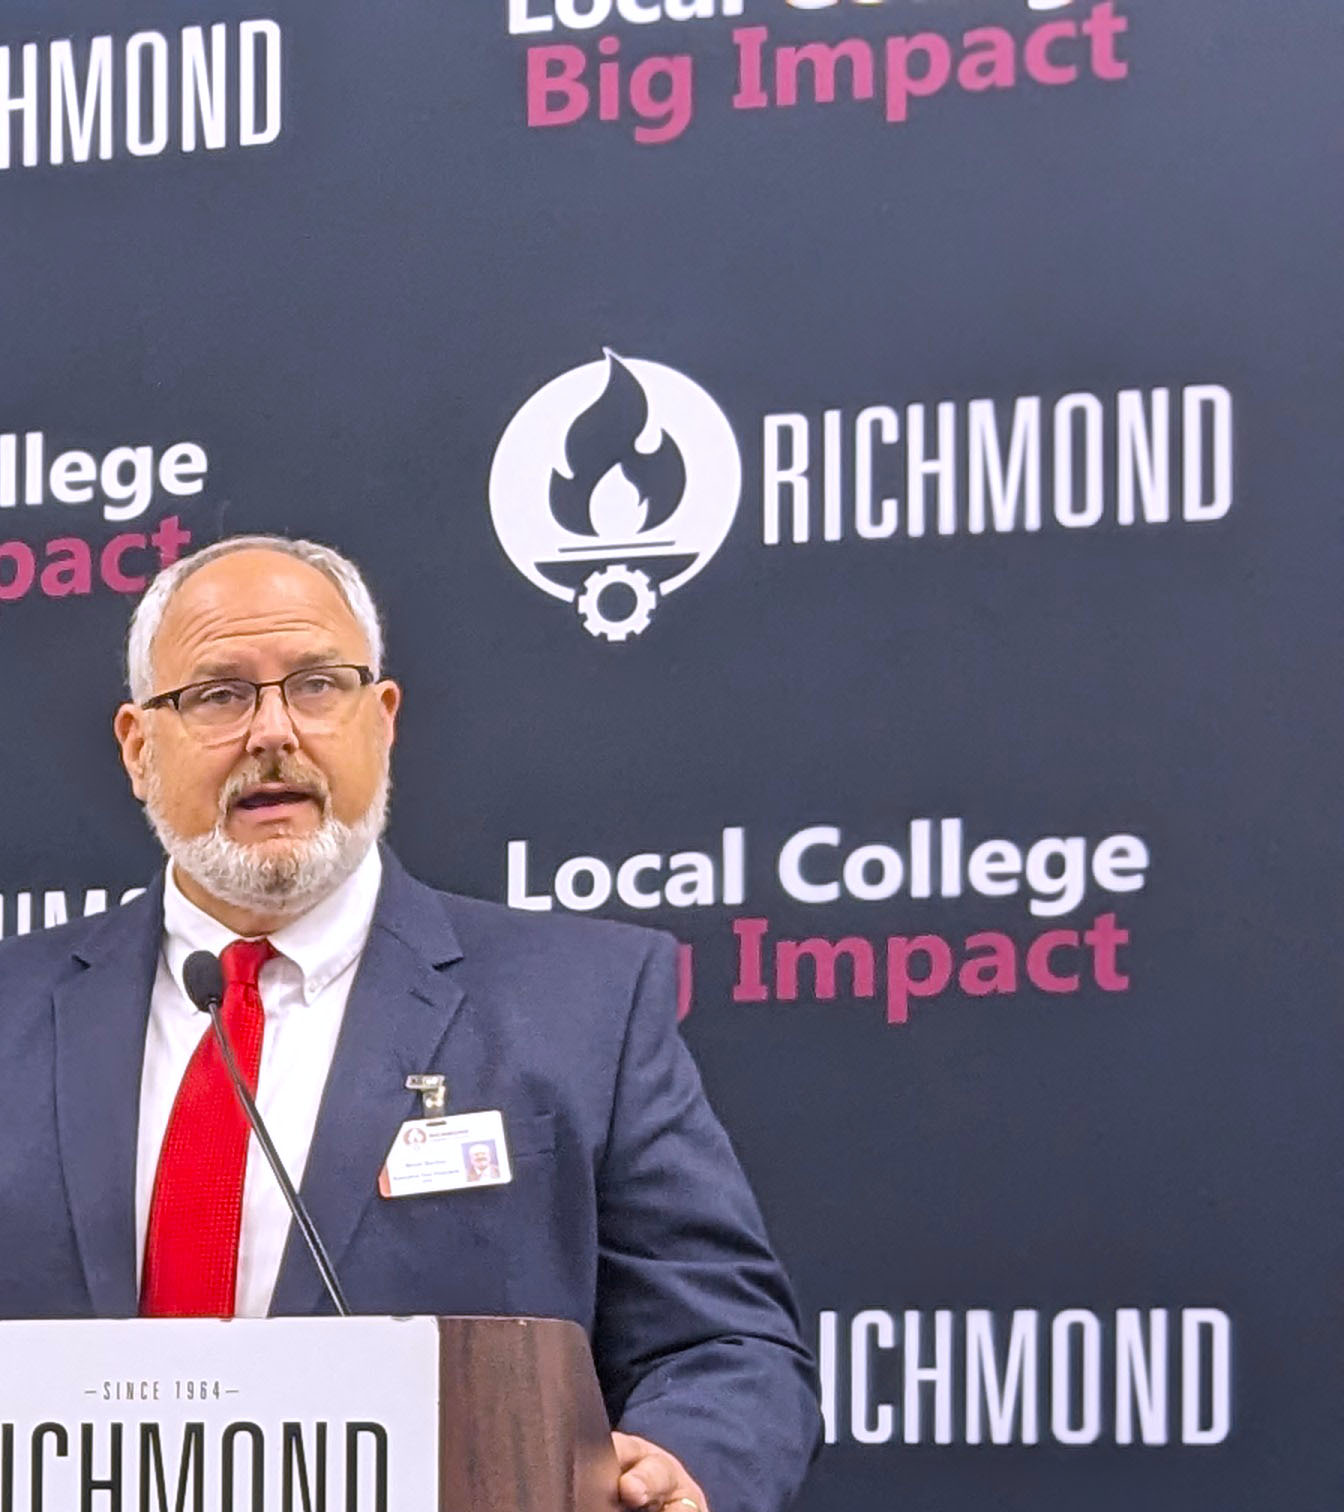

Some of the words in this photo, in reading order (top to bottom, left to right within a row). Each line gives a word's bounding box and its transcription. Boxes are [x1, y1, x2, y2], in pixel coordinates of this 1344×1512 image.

[528, 36, 692, 142] Big
[733, 2, 1126, 121] Impact
[764, 385, 1232, 544] RICHMOND
[508, 827, 744, 911] Local
[779, 818, 1148, 916] College
[733, 915, 1128, 1023] Impact
[820, 1309, 1229, 1444] ICHMOND
